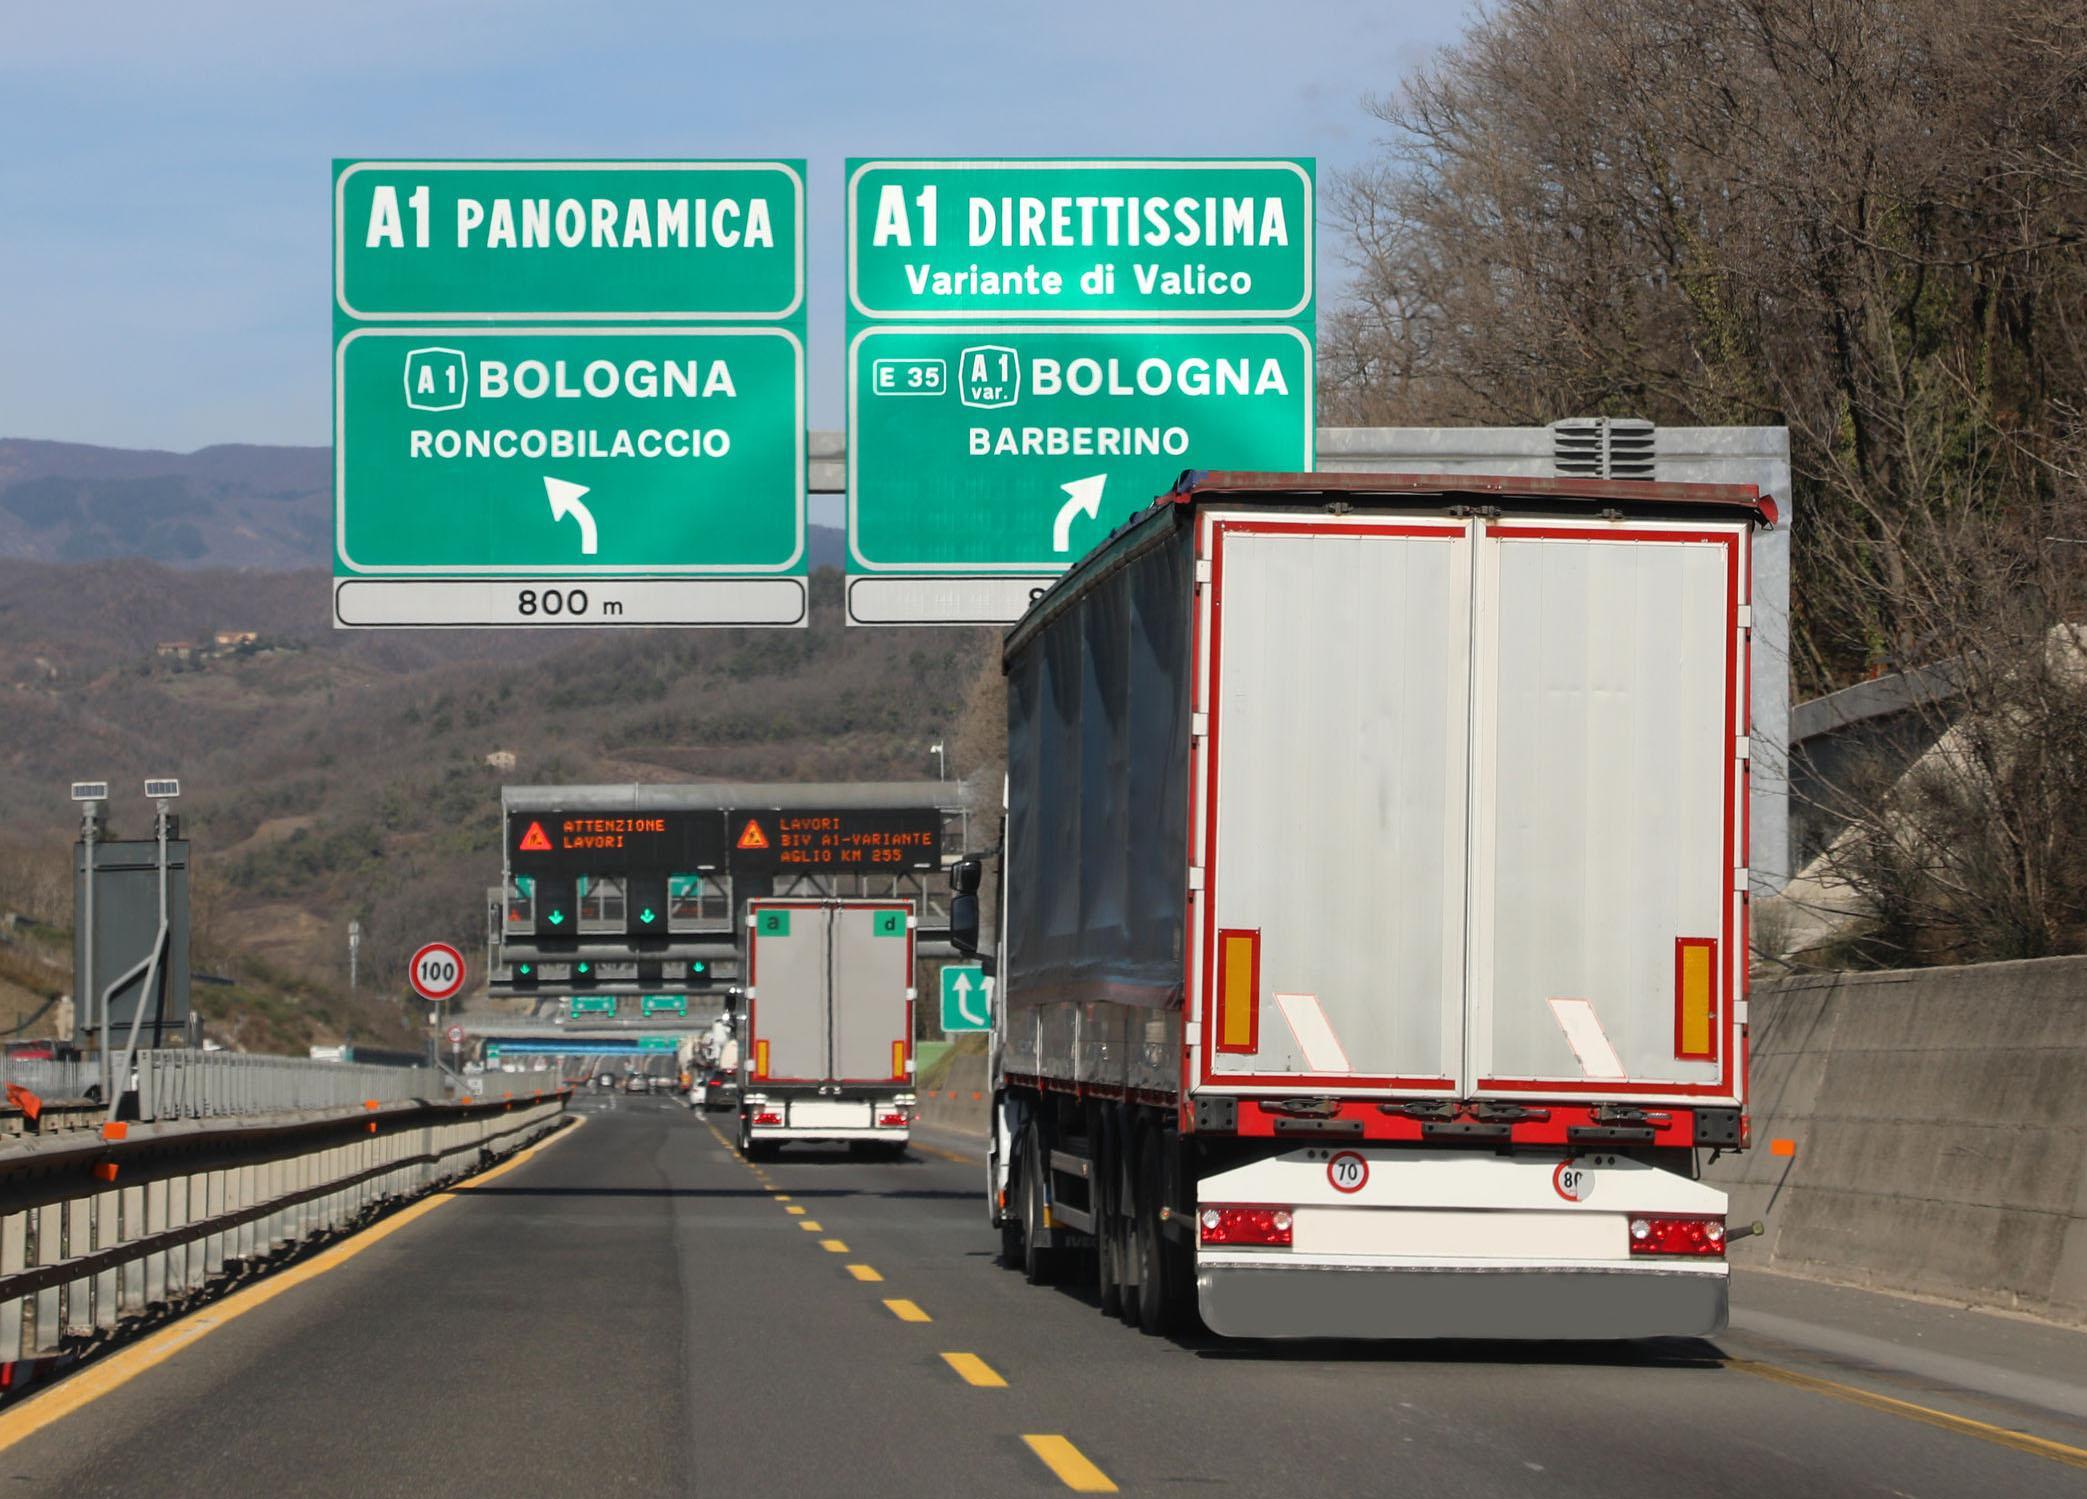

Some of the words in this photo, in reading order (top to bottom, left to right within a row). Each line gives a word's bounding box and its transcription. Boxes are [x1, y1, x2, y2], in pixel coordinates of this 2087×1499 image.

[366, 185, 430, 248] A1
[457, 198, 774, 248] PANORAMICA
[872, 184, 937, 247] A1
[969, 197, 1289, 247] DIRETTISSIMA
[904, 264, 1063, 295] Variante
[1080, 264, 1115, 295] di
[1133, 264, 1252, 295] Valico
[479, 360, 737, 399] BOLOGNA
[879, 367, 895, 387] E
[907, 367, 940, 387] 35
[1032, 358, 1289, 396] BOLOGNA
[972, 387, 1008, 401] var.
[410, 429, 730, 458] RONCOBILACCIO
[969, 427, 1189, 455] BARBERINO
[518, 589, 589, 616] 800
[603, 601, 623, 615] m
[563, 820, 665, 832] ATTENZIONE
[780, 818, 840, 830] LAVORI
[563, 836, 624, 848] LAVORI
[780, 834, 812, 847] BIV
[821, 832, 932, 846] A1-VARIANTE
[780, 851, 832, 862] AGLIO
[841, 850, 861, 861] KM
[767, 916, 779, 930] a
[884, 916, 896, 931] d
[421, 962, 454, 981] 100
[1339, 1163, 1357, 1181] 70
